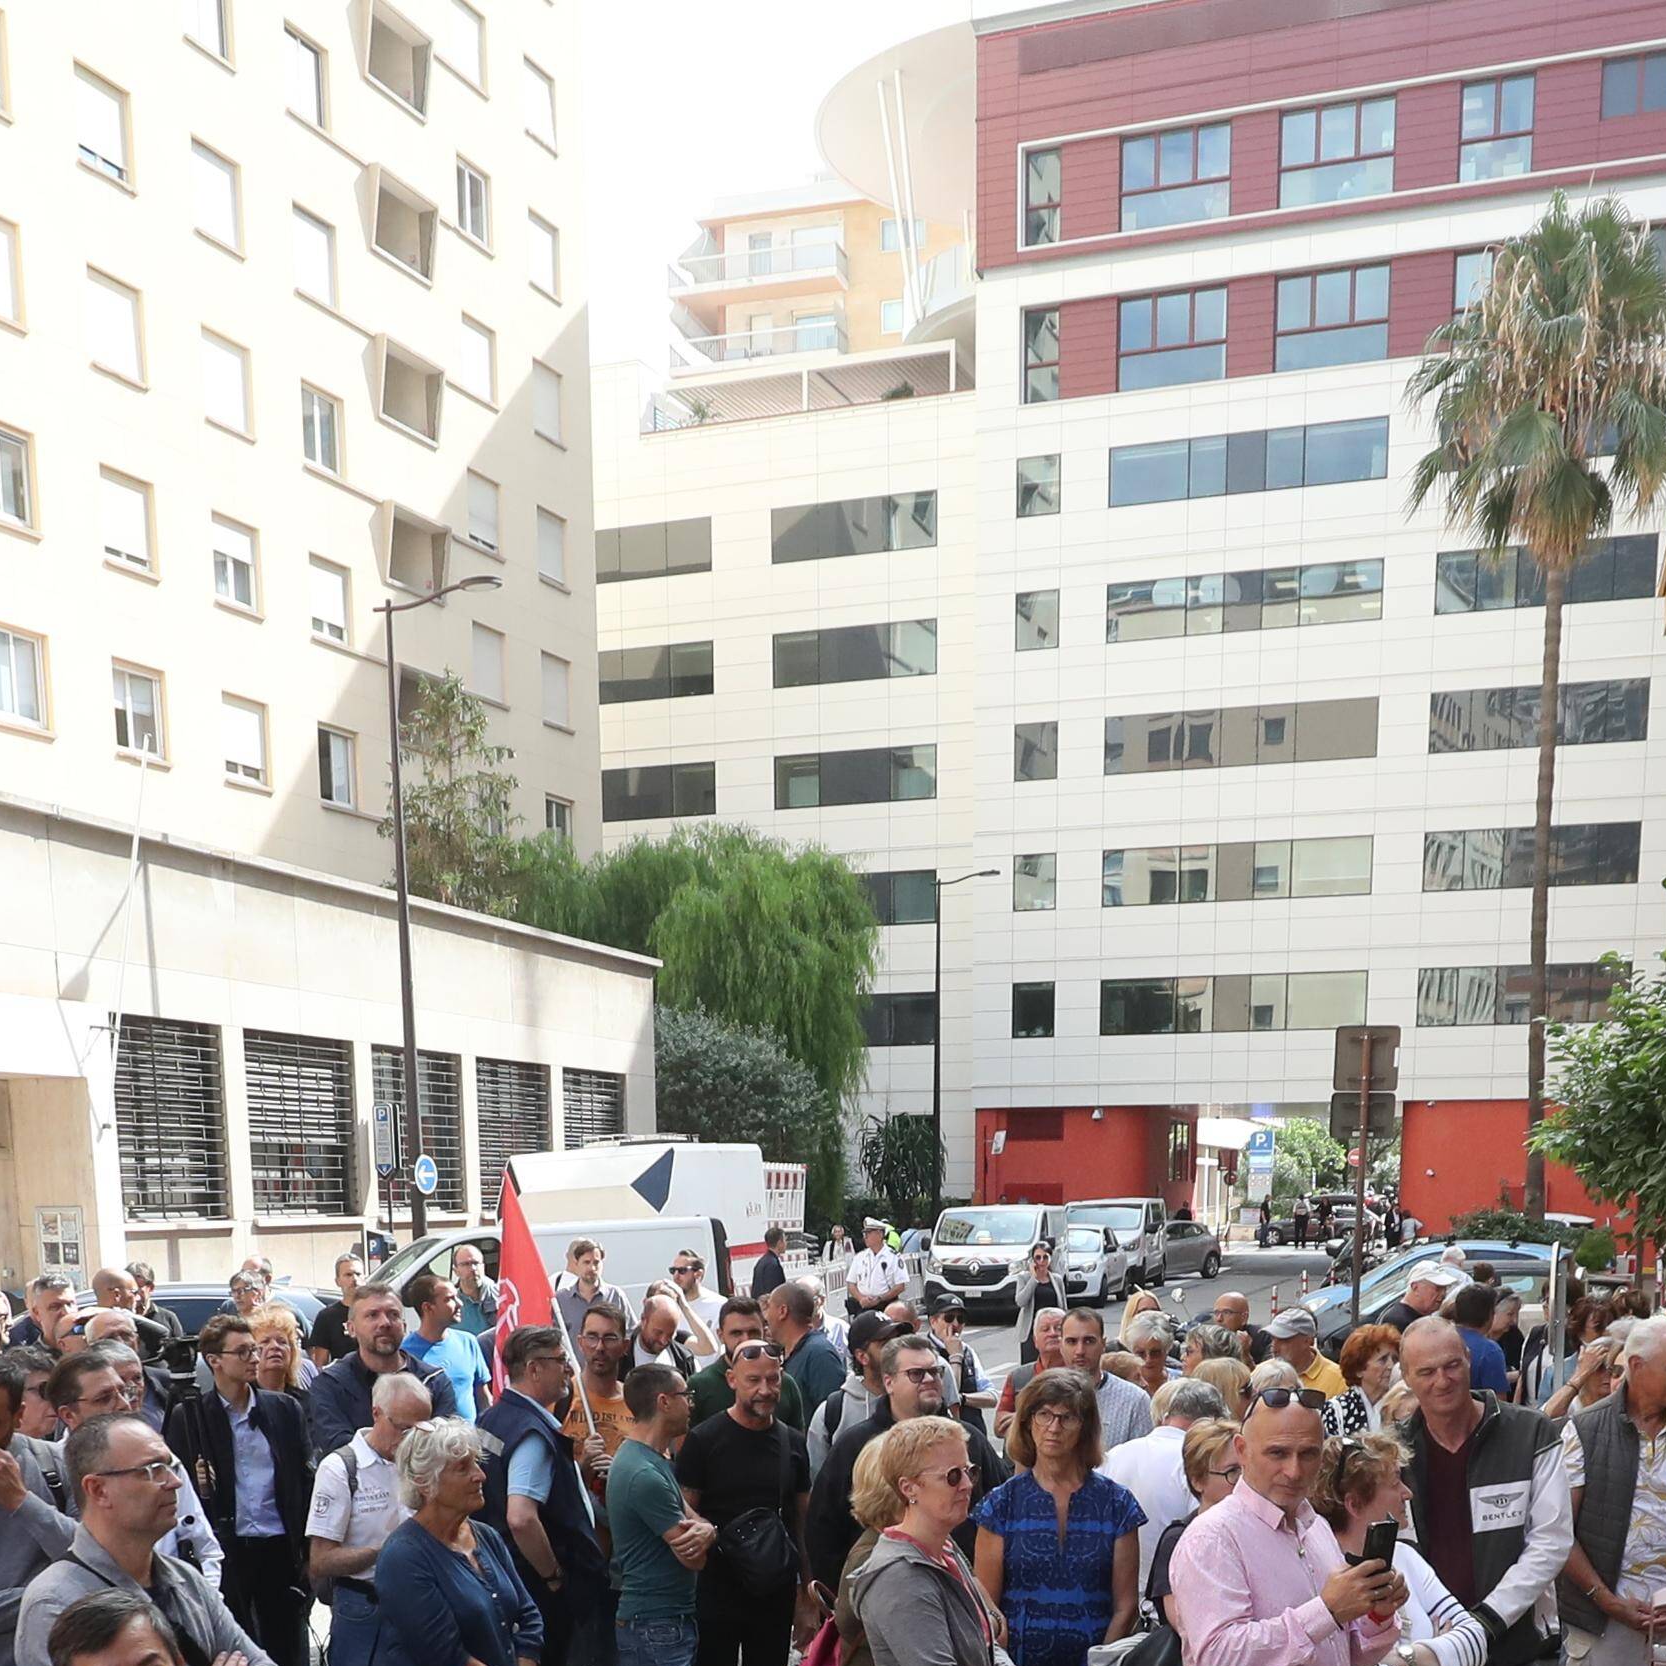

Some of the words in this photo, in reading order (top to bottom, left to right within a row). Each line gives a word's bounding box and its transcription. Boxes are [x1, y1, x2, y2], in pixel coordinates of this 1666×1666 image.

[377, 1108, 386, 1120] P
[1255, 1133, 1267, 1147] P
[369, 1239, 377, 1252] P
[1481, 1510, 1524, 1522] BENTLEY
